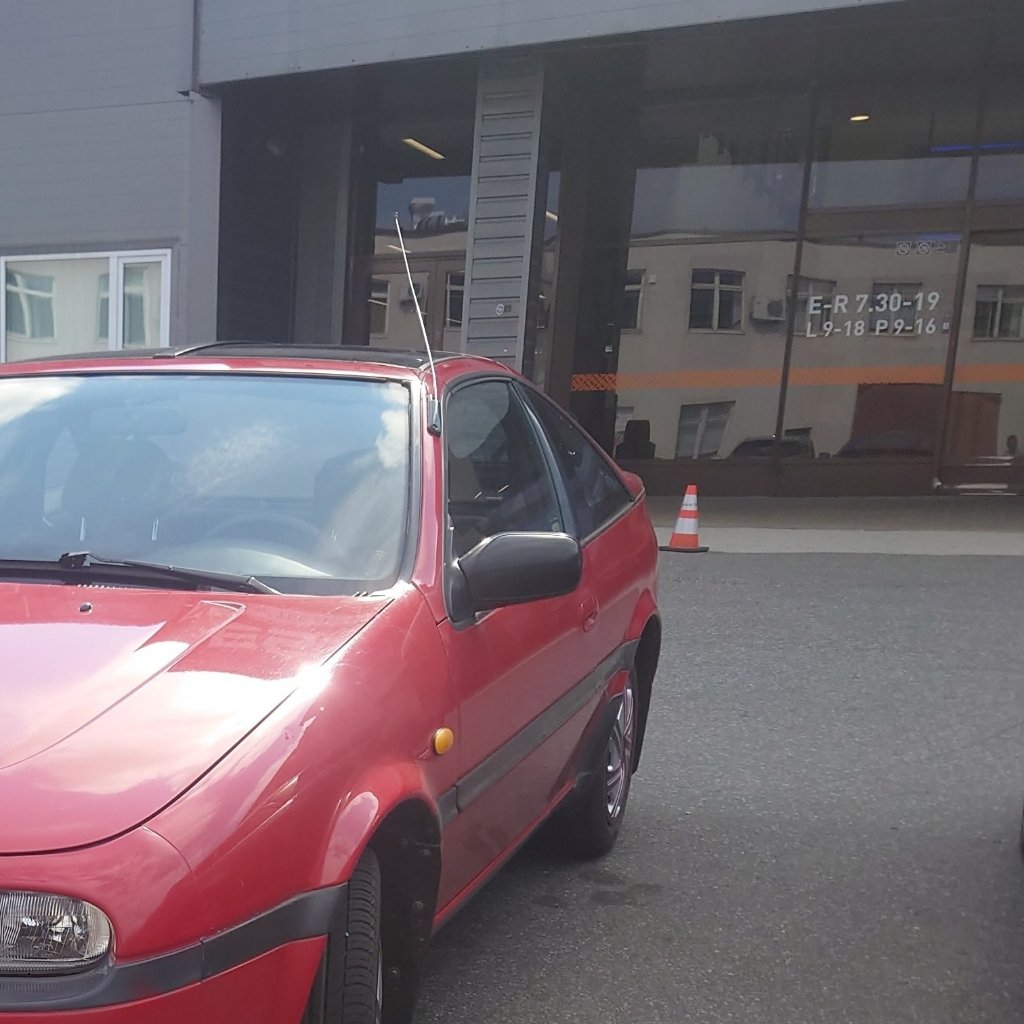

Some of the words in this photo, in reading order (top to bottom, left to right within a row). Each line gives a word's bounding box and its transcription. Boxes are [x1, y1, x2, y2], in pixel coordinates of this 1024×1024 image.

[809, 294, 849, 314] E-R
[855, 292, 941, 313] 7.30-19
[806, 322, 817, 338] L
[823, 320, 865, 337] 9-18
[876, 320, 889, 336] P
[893, 318, 936, 336] 9-16
